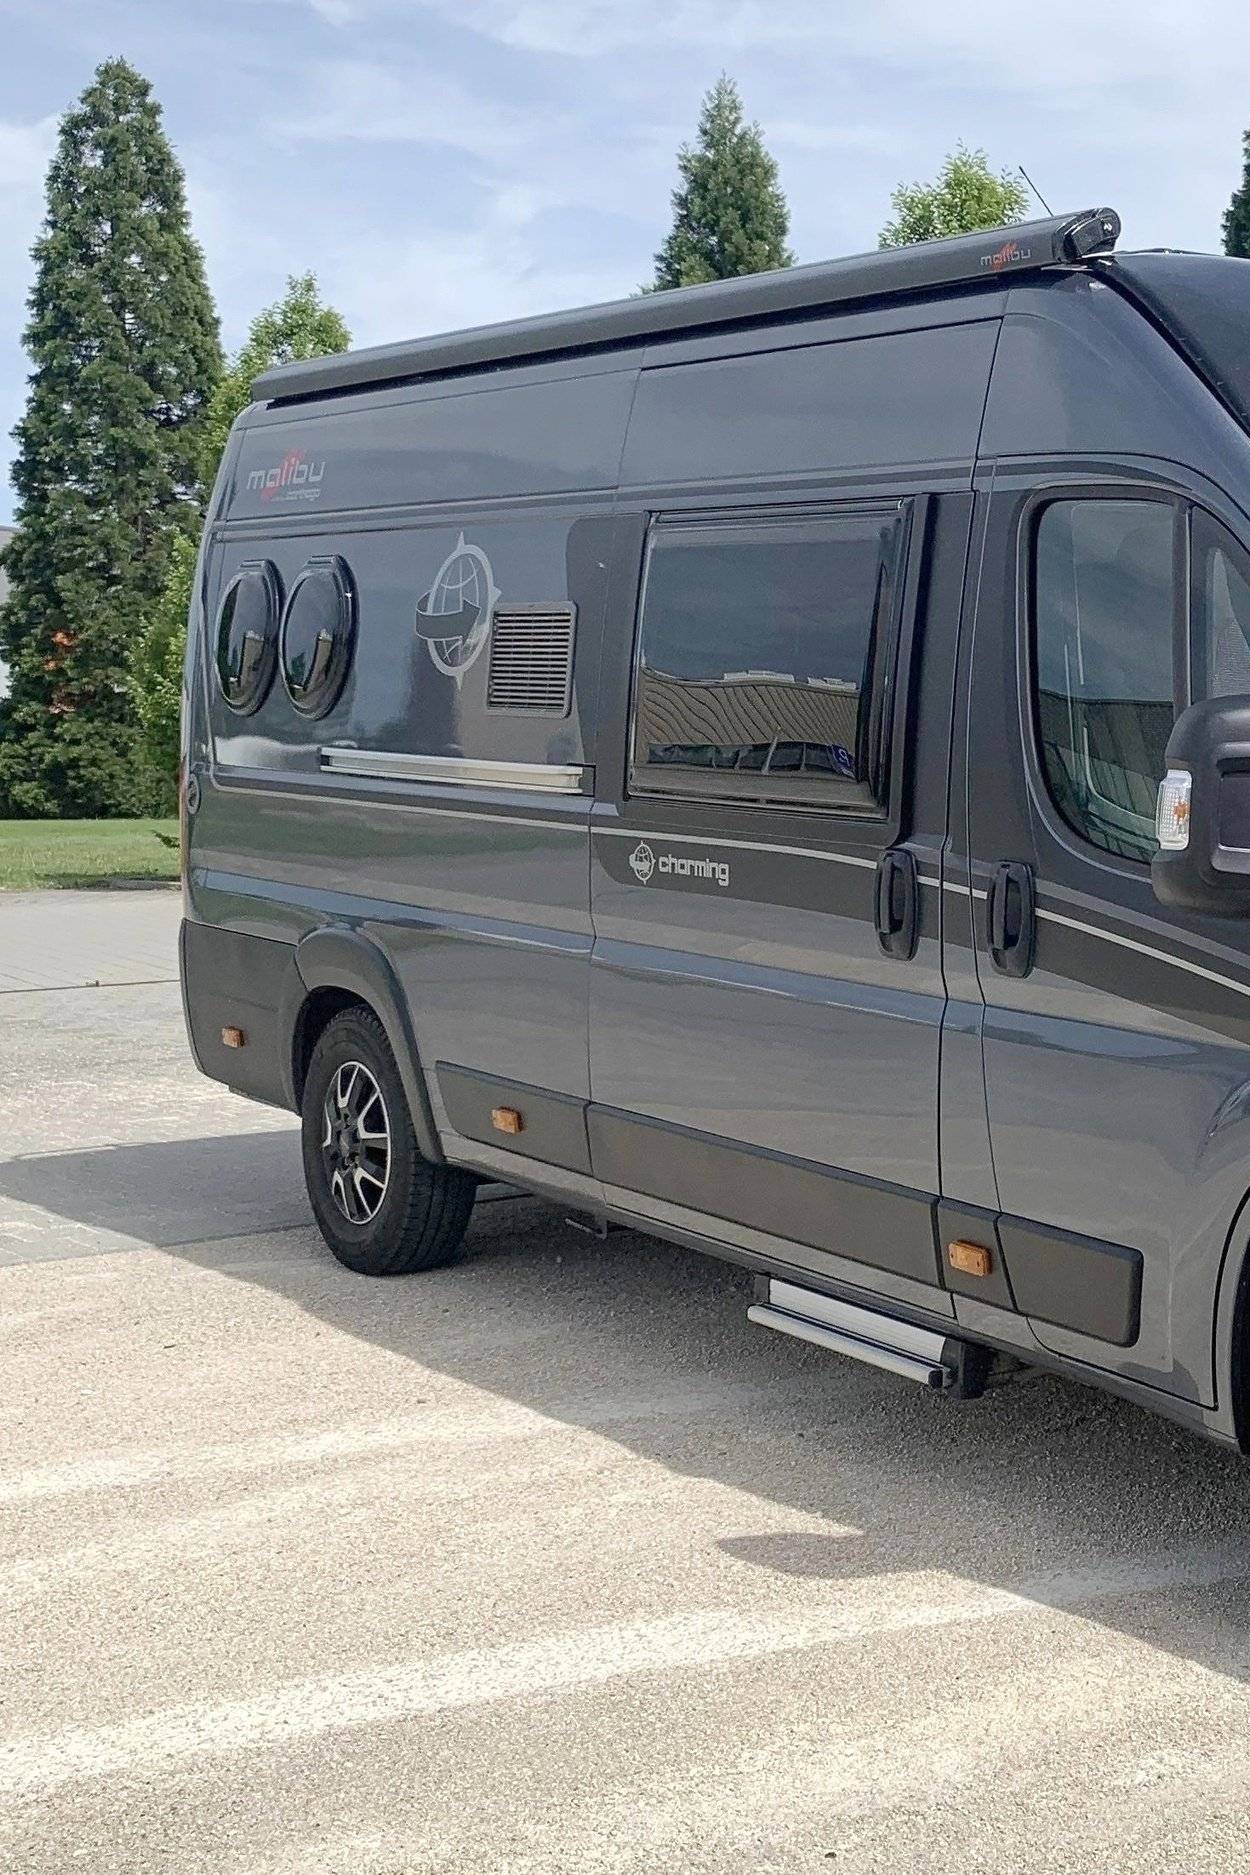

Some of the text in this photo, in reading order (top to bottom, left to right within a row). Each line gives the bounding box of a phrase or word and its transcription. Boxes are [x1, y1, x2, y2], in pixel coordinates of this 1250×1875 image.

[980, 245, 1031, 267] malibu
[246, 456, 326, 490] malibu
[658, 854, 730, 887] charming
